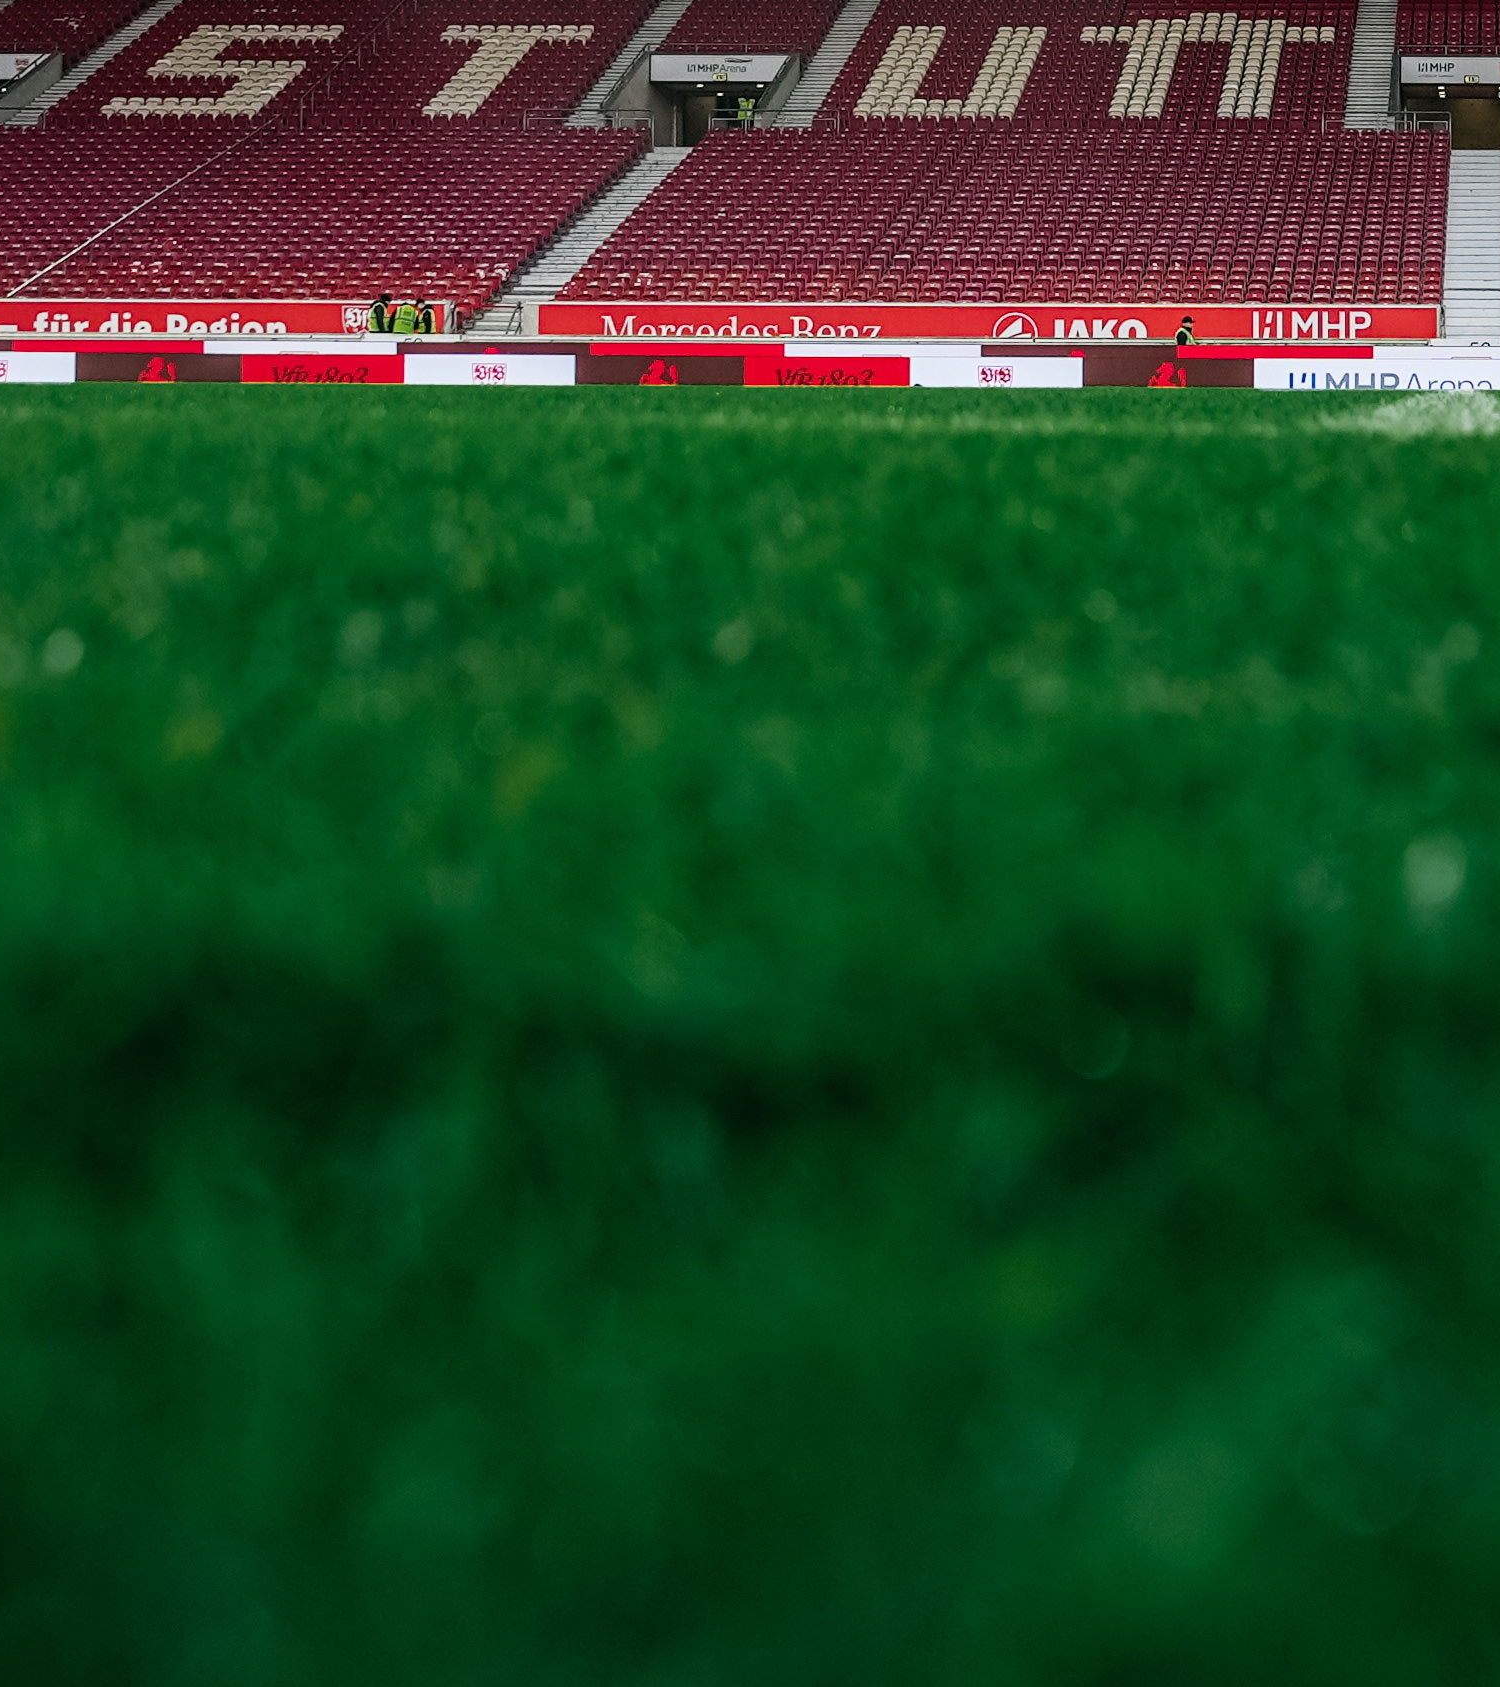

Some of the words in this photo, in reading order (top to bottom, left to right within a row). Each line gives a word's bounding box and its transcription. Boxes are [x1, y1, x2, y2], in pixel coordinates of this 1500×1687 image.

[1430, 63, 1455, 72] MHP
[33, 311, 89, 333] für
[100, 312, 152, 333] die
[1291, 310, 1372, 339] MHP
